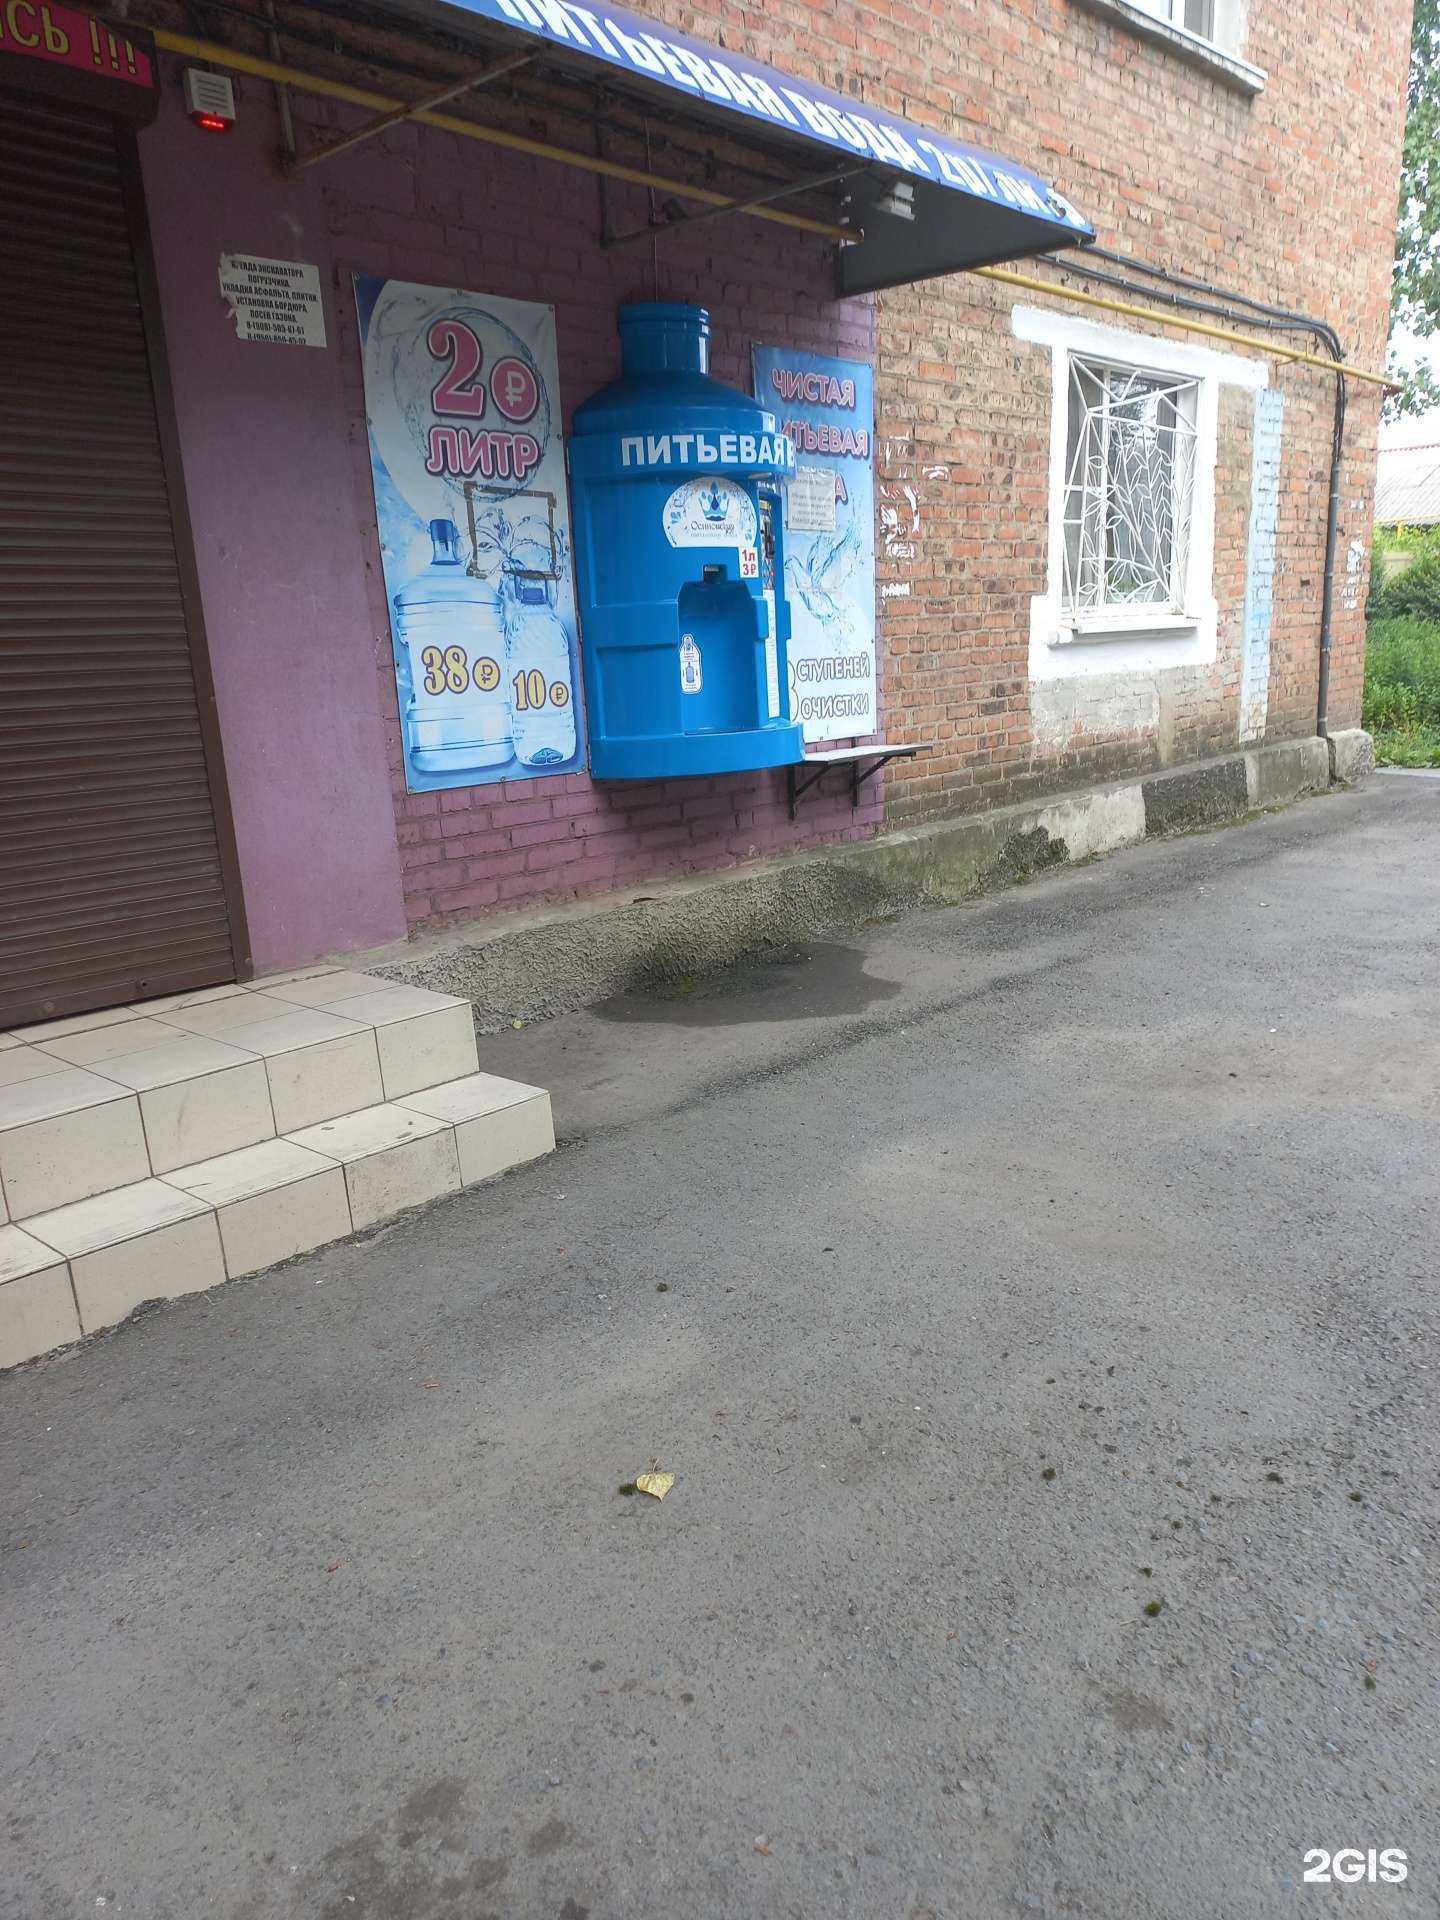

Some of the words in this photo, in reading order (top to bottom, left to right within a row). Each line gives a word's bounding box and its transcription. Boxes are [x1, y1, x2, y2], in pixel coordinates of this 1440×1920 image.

[0, 0, 69, 54] СЬ
[780, 86, 931, 174] ВОДА
[427, 318, 486, 420] 2
[772, 368, 856, 411] ЧИСТАЯ
[425, 424, 543, 481] ЛИТР
[621, 433, 787, 467] ПИТЬЕВАЯ
[781, 417, 870, 459] ТЬЕВАЯ
[742, 549, 756, 562] 1л
[421, 645, 469, 696] 38
[796, 651, 871, 683] СТУПЕНЕЙ
[512, 668, 546, 711] 10
[801, 692, 869, 721] ОЧИСТКИ
